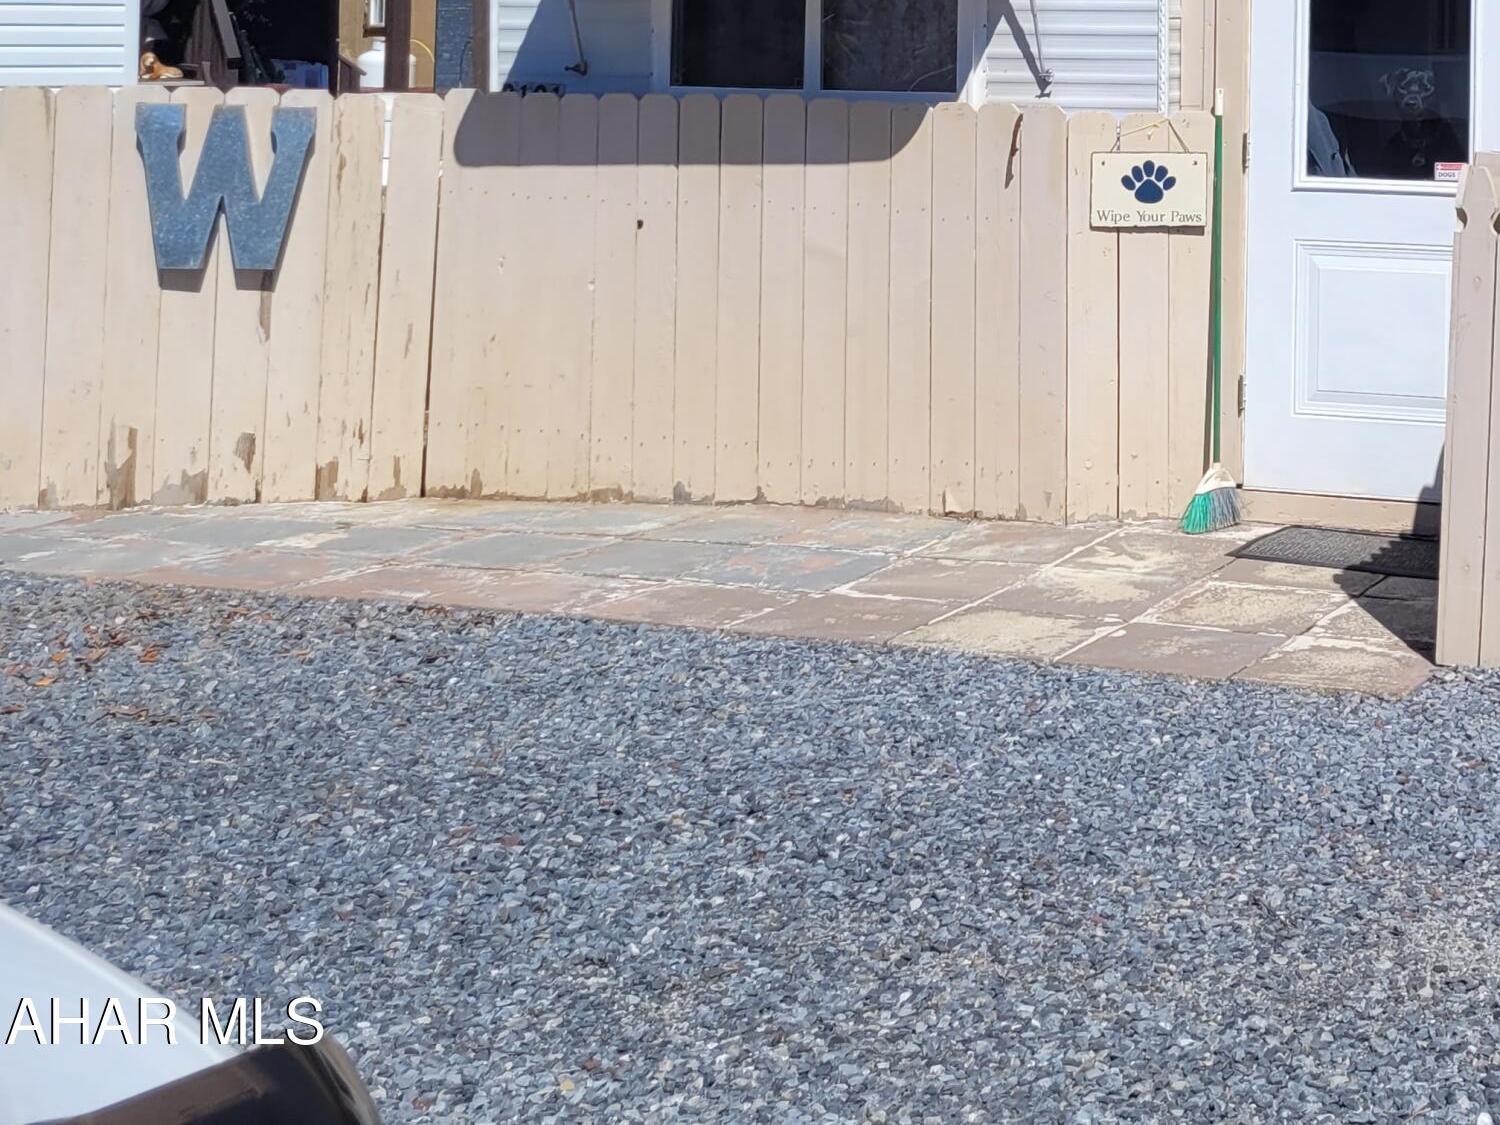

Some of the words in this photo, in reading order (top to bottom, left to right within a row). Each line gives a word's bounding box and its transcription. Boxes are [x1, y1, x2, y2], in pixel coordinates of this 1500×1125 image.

[134, 102, 318, 269] W
[1096, 210, 1131, 224] Wipe
[1136, 210, 1166, 222] Your
[1170, 210, 1202, 223] Paws
